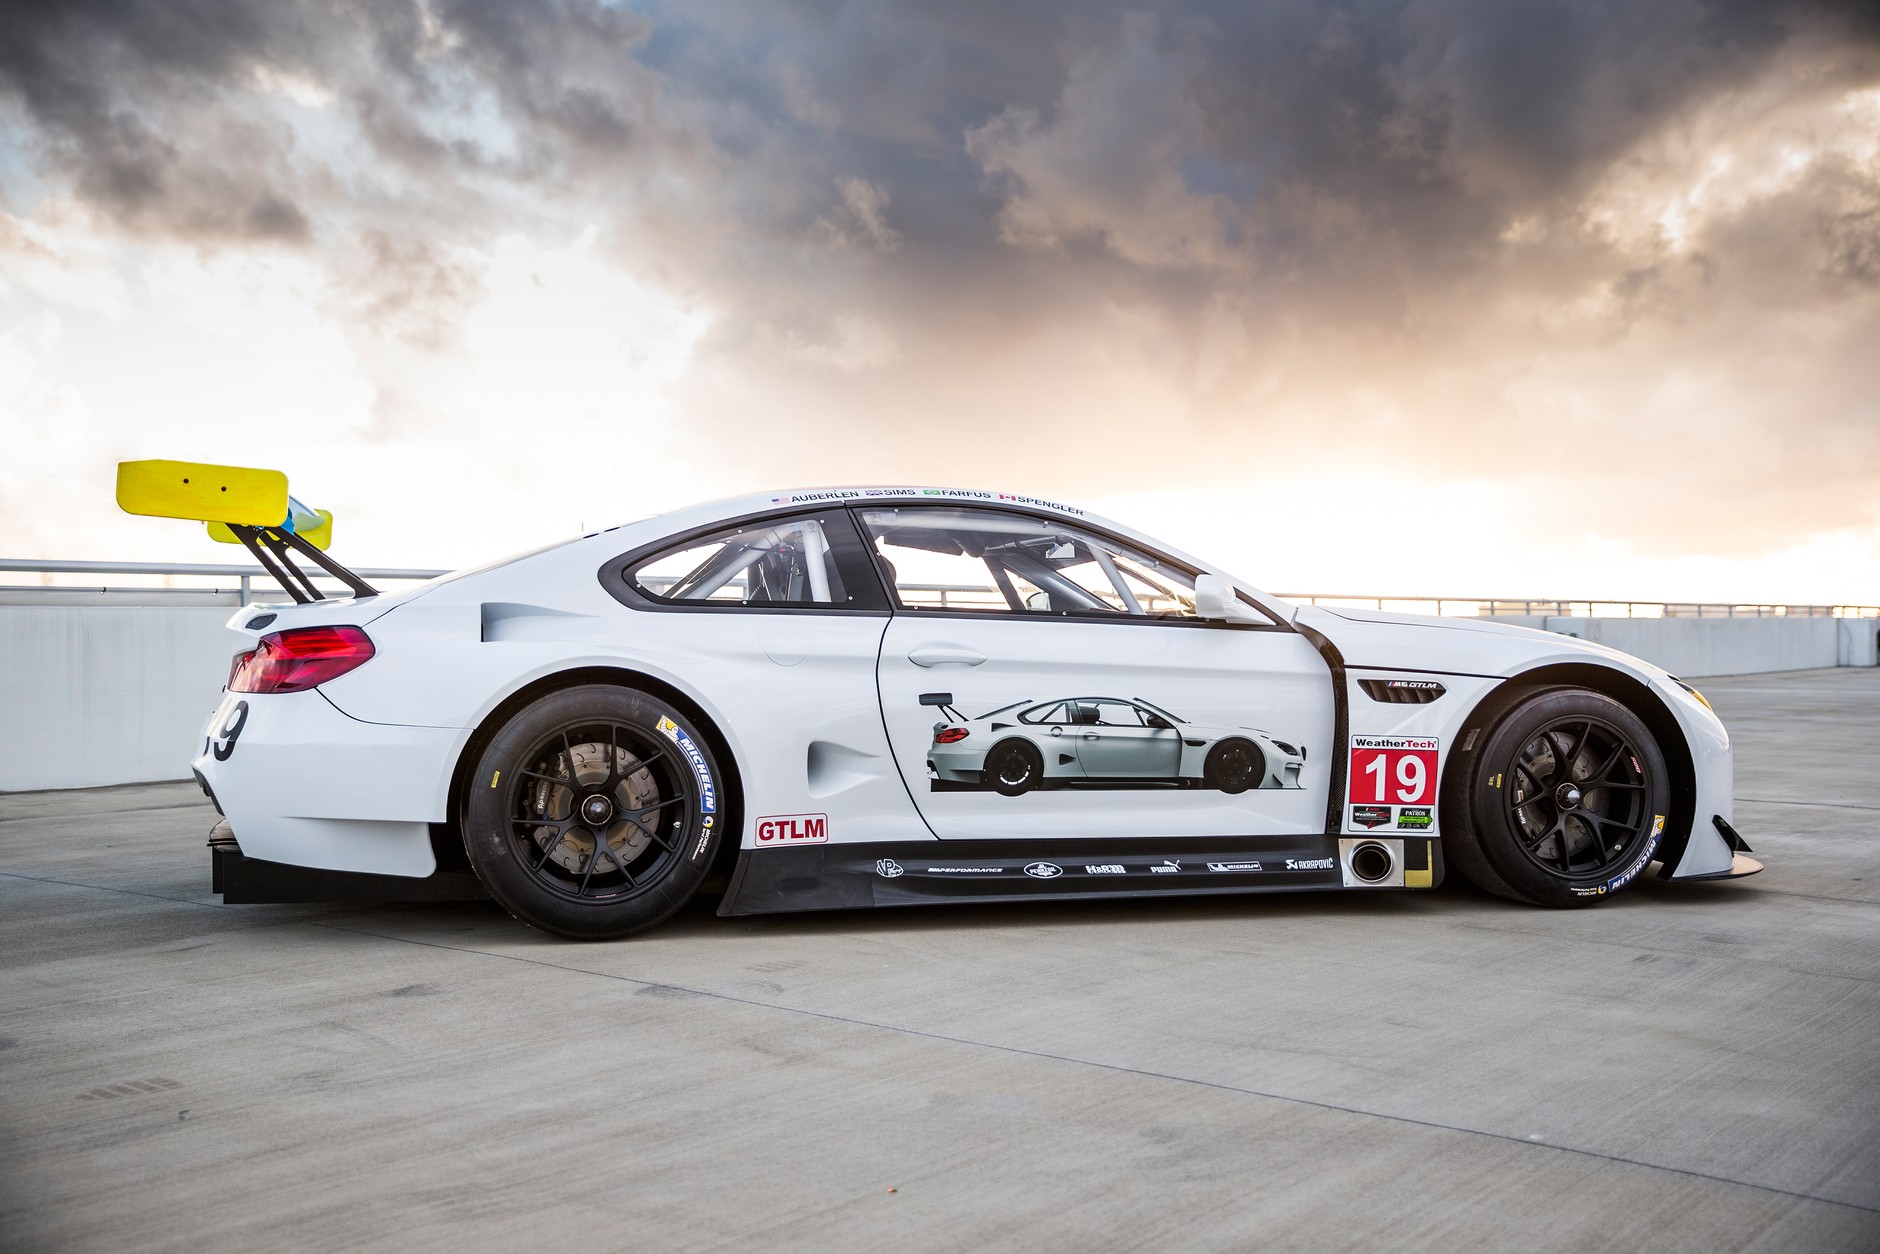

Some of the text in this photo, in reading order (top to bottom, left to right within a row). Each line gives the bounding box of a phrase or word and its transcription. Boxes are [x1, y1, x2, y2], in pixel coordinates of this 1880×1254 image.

[791, 490, 860, 503] AUBERLEN
[941, 490, 991, 498] FARFUS
[1017, 496, 1084, 516] SPENGLER
[1356, 738, 1435, 748] WeatherTech
[679, 737, 714, 809] MICHELIN
[1365, 753, 1427, 803] 19
[758, 818, 825, 841] GTLM
[877, 859, 896, 876] VP
[1611, 839, 1656, 890] MICHELIN
